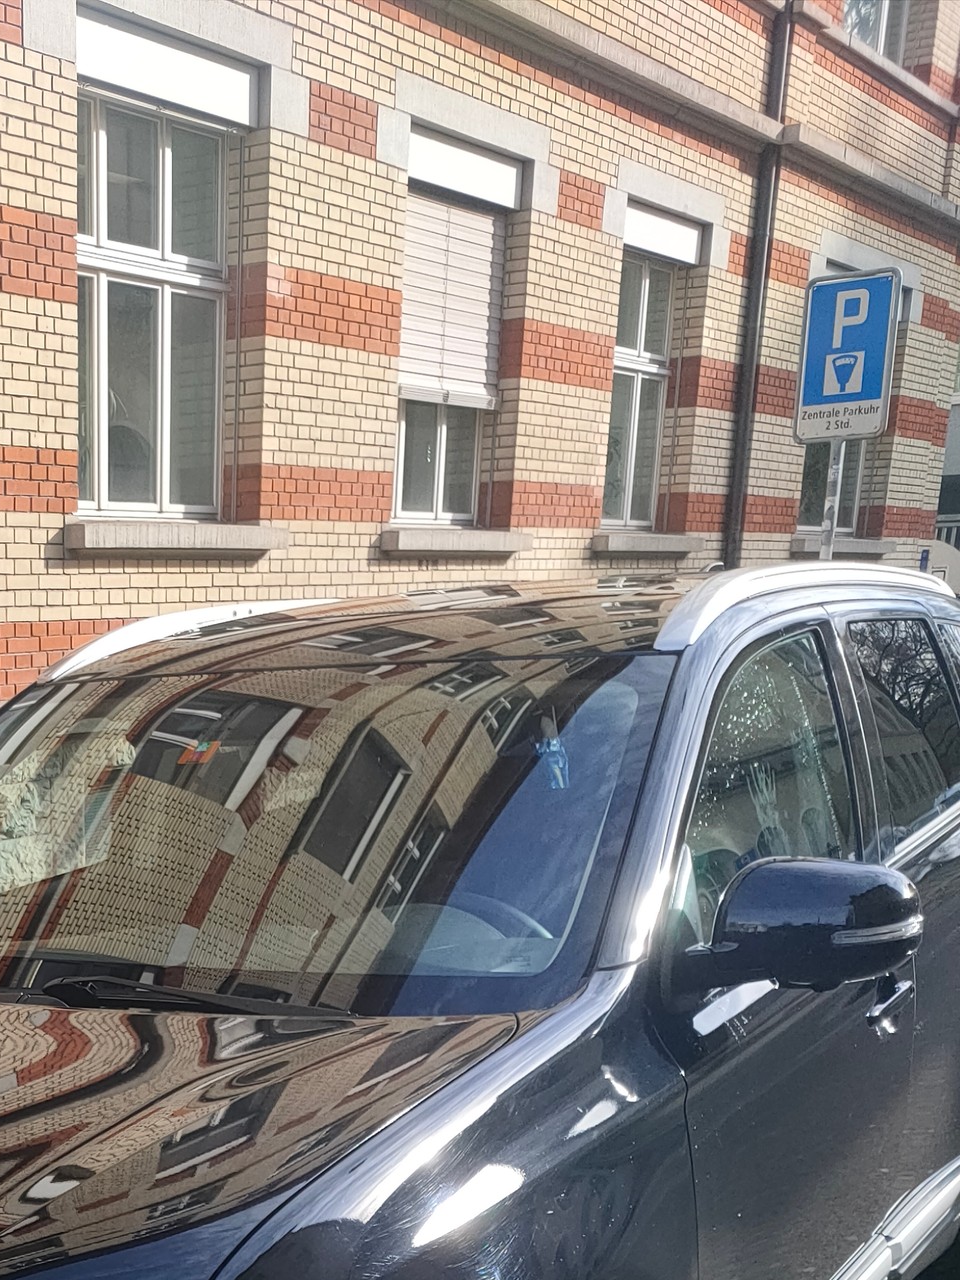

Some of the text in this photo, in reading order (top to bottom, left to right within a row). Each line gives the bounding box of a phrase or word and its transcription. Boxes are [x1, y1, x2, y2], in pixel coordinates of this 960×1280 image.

[832, 288, 870, 349] P
[801, 404, 880, 421] Zentrale Parkuhr
[825, 419, 852, 431] 2 Std.
